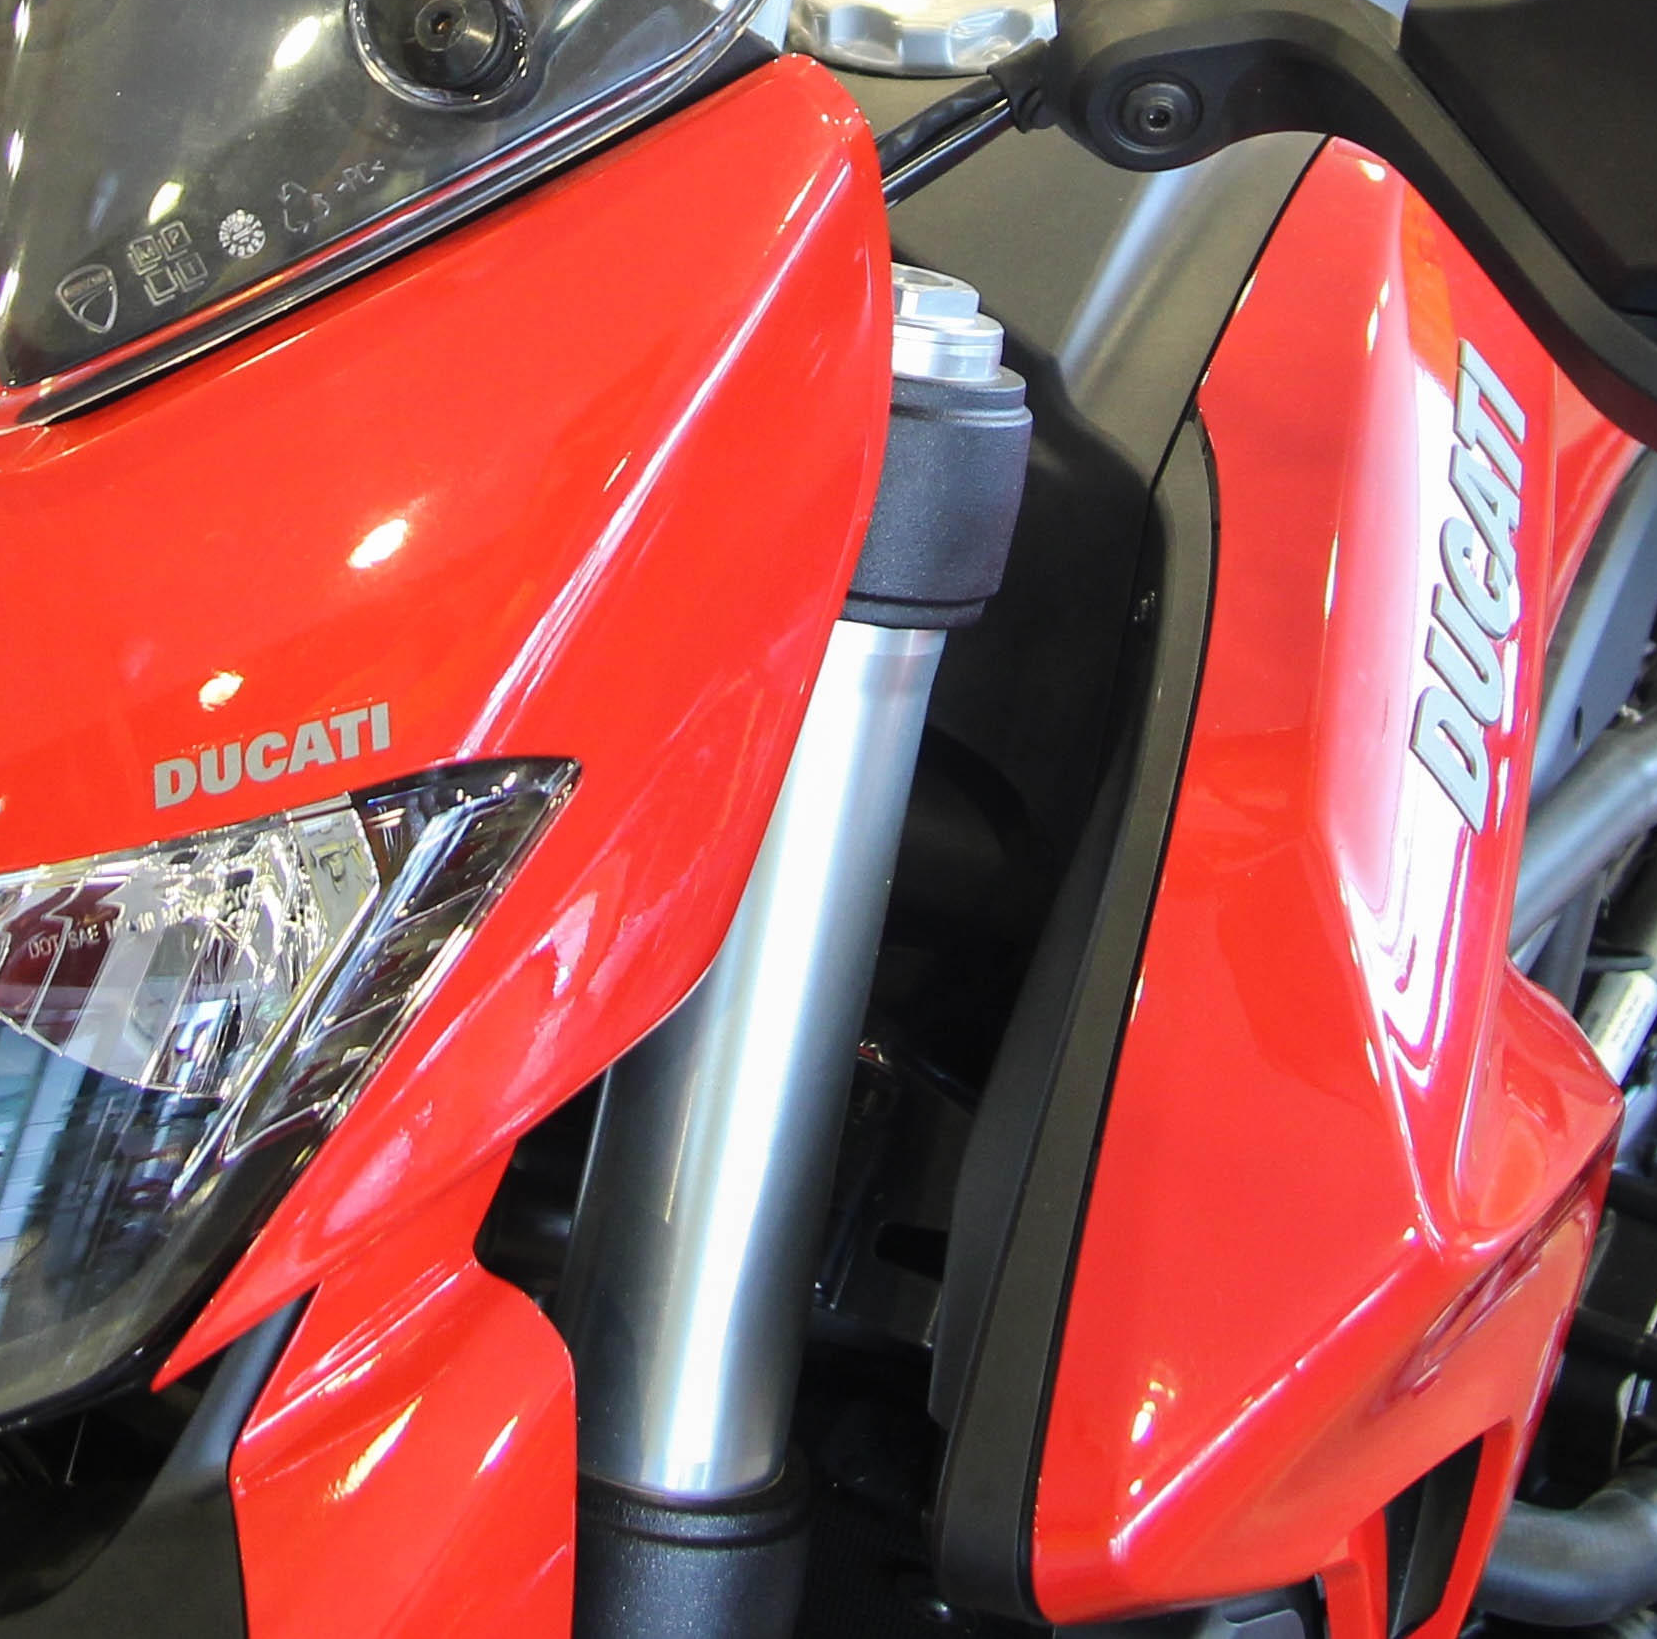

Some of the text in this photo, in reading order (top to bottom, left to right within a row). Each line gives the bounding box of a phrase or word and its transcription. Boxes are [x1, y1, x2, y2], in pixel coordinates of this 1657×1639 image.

[1412, 339, 1525, 833] DUCATI
[153, 702, 390, 809] DUCATI
[28, 923, 100, 959] DOT SAE
